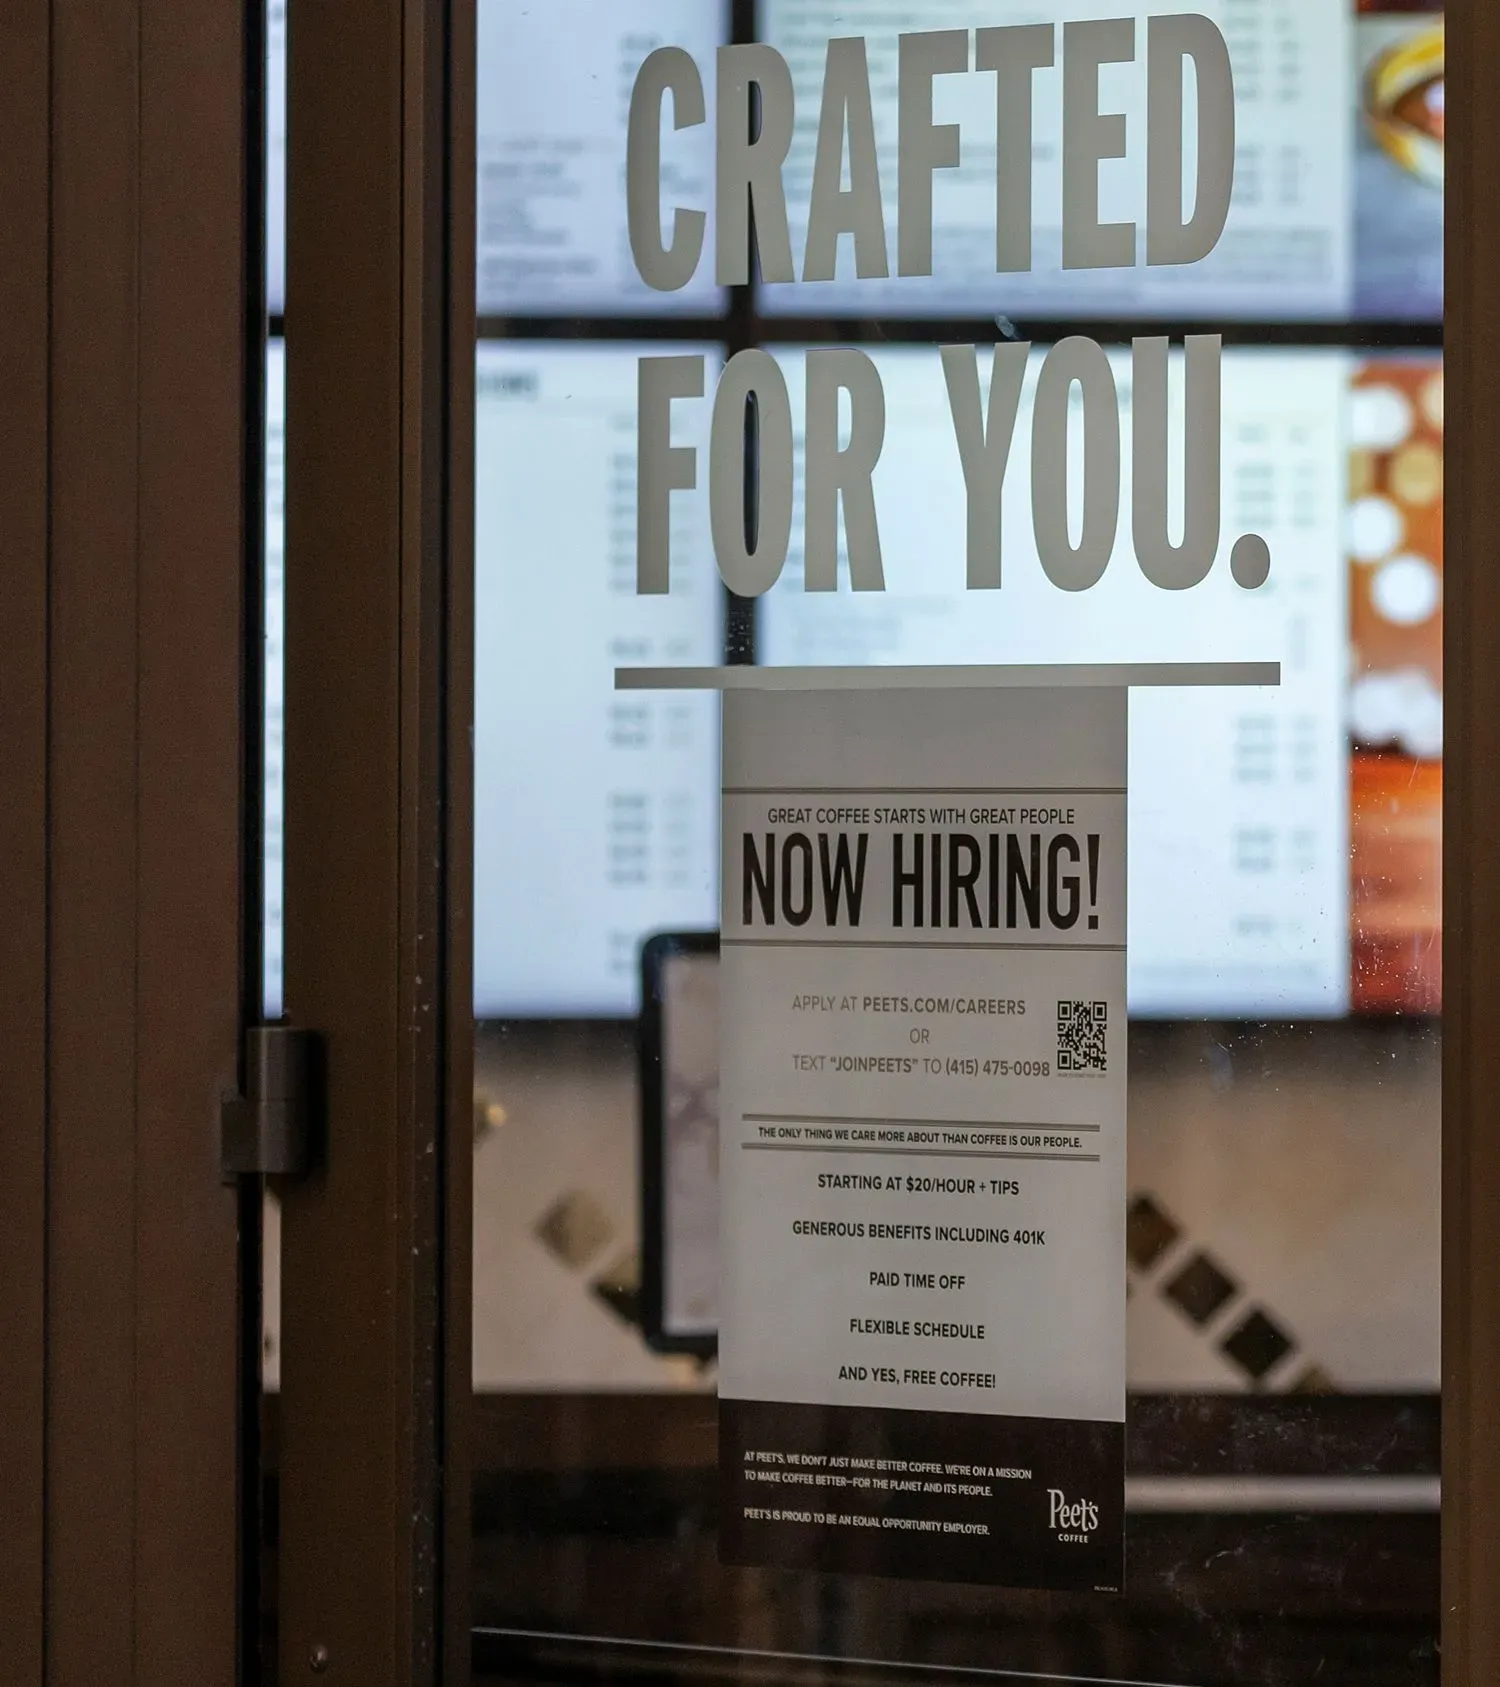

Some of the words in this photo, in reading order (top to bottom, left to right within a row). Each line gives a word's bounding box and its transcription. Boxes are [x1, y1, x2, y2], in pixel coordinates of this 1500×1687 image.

[626, 13, 1236, 292] CRAFTED
[636, 347, 886, 597] FOR
[939, 333, 1271, 592] YOU.
[768, 808, 812, 824] GREAT
[816, 808, 869, 824] COFFEE
[874, 808, 926, 824] STARTS
[929, 808, 965, 824] WITH
[970, 808, 1014, 824] GREAT
[1020, 808, 1075, 824] PEOPLE
[742, 832, 869, 927] NOW
[892, 833, 1100, 930] HIRING!
[792, 995, 835, 1012] APPLY
[840, 996, 857, 1012] AT
[863, 997, 1026, 1015] PEETS.COM/CAREERS
[909, 1028, 930, 1044] OR
[792, 1054, 826, 1071] TEXT
[923, 1058, 941, 1074] TO
[945, 1059, 979, 1077] (415)
[982, 1060, 1050, 1077] 475-0098
[758, 1127, 776, 1138] THE
[778, 1127, 801, 1138] ONLY
[804, 1128, 832, 1139] THING
[834, 1129, 849, 1140] WE
[851, 1130, 876, 1141] CARE
[878, 1131, 904, 1142] MORE
[907, 1132, 939, 1143] ABOUT
[942, 1133, 968, 1144] THAN
[971, 1134, 1006, 1145] COFFEE
[1009, 1135, 1018, 1146] IS
[1020, 1135, 1041, 1146] OUR
[1043, 1136, 1082, 1148] PEOPLE.
[818, 1174, 882, 1190] STARTING
[885, 1176, 902, 1191] AT
[906, 1176, 975, 1194] $20/HOUR
[979, 1182, 986, 1192] +
[990, 1180, 1019, 1195] TIPS
[792, 1220, 864, 1237] GENEROUS
[868, 1223, 931, 1241] BENEFITS
[935, 1226, 1009, 1243] INCLUDING
[1013, 1230, 1046, 1245] 401K
[869, 1272, 900, 1287] PAID
[904, 1273, 935, 1289] TIME
[939, 1275, 965, 1290] OFF
[849, 1319, 910, 1335] FLEXIBLE
[913, 1322, 985, 1340] SCHEDULE
[838, 1366, 867, 1381] AND
[871, 1367, 900, 1385] YES,
[904, 1369, 936, 1385] FREE
[940, 1371, 996, 1389] COFFEE!
[744, 1451, 755, 1461] AT
[786, 1454, 800, 1464] WE
[801, 1454, 828, 1466] DON'T
[829, 1456, 849, 1467] JUST
[851, 1458, 875, 1469] MAKE
[877, 1459, 907, 1472] BETTER
[945, 1464, 971, 1476] WE'RE
[972, 1466, 986, 1477] ON
[987, 1467, 995, 1477] A
[996, 1468, 1032, 1480] MISSION
[744, 1470, 756, 1481] TO
[757, 1471, 780, 1482] MAKE
[782, 1472, 814, 1485] COFFEE
[872, 1479, 889, 1489] THE
[890, 1480, 922, 1492] PLANET
[923, 1482, 942, 1493] AND
[943, 1483, 957, 1494] ITS
[958, 1484, 993, 1496] PEOPLE.
[744, 1507, 772, 1520] PEET'S
[773, 1509, 780, 1520] IS
[782, 1510, 811, 1523] PROUD
[813, 1512, 825, 1524] TO
[826, 1513, 837, 1524] BE
[839, 1514, 851, 1526] AN
[853, 1515, 881, 1528] EQUAL
[882, 1517, 941, 1532] OPPORTUNITY
[943, 1522, 990, 1535] EMPLOYER.
[1046, 1488, 1099, 1532] Peet's
[1058, 1533, 1089, 1544] COFFEE
